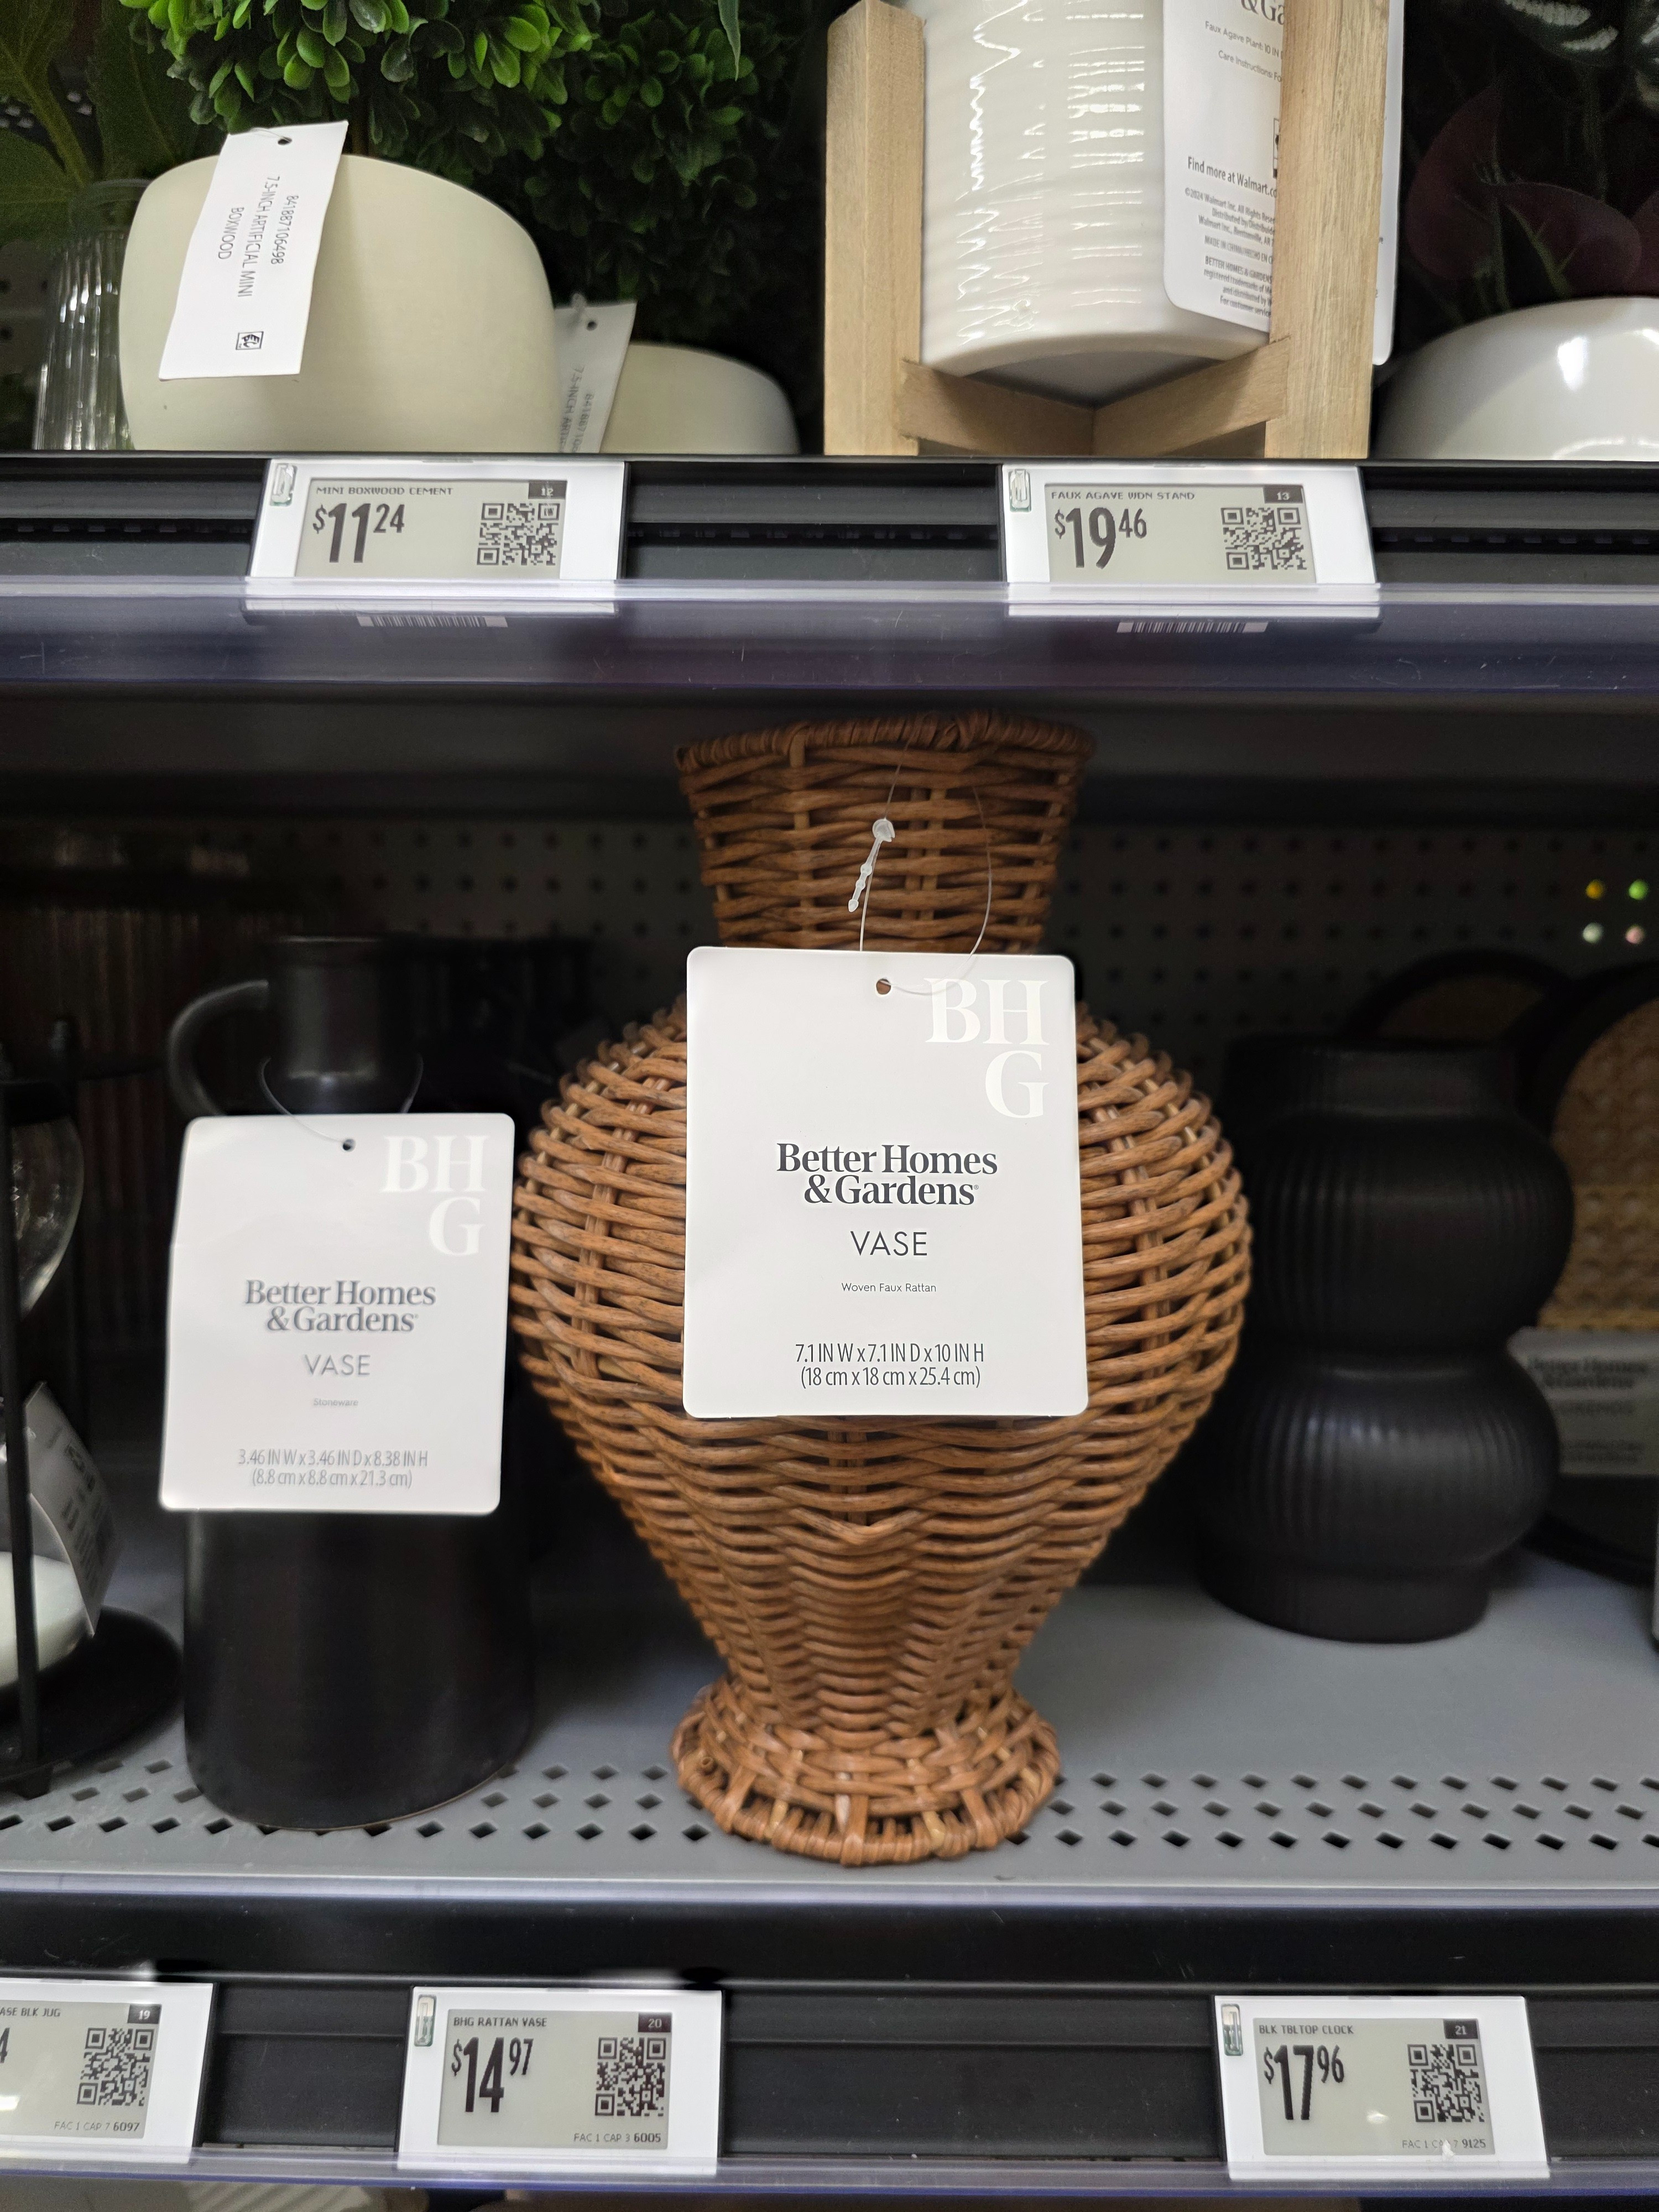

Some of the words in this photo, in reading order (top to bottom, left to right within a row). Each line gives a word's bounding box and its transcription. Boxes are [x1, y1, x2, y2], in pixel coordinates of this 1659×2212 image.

[1205, 20, 1221, 34] Faux
[1223, 28, 1244, 43] Agave
[1265, 44, 1271, 54] 10
[1272, 48, 1279, 58] IN
[1218, 50, 1234, 63] Care
[1188, 156, 1204, 174] Find
[1207, 165, 1226, 181] more
[1228, 172, 1235, 184] at
[1204, 193, 1227, 208] Walmart
[271, 195, 299, 264] 841887106498
[1198, 215, 1221, 230] Walmart
[218, 207, 244, 260] BOXWOOD
[242, 215, 268, 268] ARTIFICIAL
[1204, 235, 1220, 248] MADE
[1220, 240, 1226, 249] IN
[1205, 255, 1225, 269] BETTER
[1225, 262, 1244, 275] HOMES
[238, 270, 256, 297] MINI
[409, 487, 454, 495] CEMENT
[1086, 492, 1123, 500] AGAVE
[1157, 492, 1195, 500] STAND
[776, 1142, 877, 1172] Better
[881, 1144, 998, 1175] Homes
[850, 1230, 927, 1256] VASE
[245, 1279, 332, 1305] Better
[335, 1280, 437, 1306] Homes
[841, 1282, 876, 1292] Woven
[879, 1283, 902, 1292] Faux
[905, 1283, 937, 1292] Rattan
[796, 1344, 813, 1362] 7.1
[818, 1343, 833, 1362] IN
[837, 1343, 854, 1362] W
[857, 1348, 865, 1362] x
[868, 1344, 886, 1362] 7.1
[891, 1343, 906, 1362] IN
[910, 1343, 921, 1362] D
[924, 1348, 932, 1362] x
[935, 1344, 951, 1362] 10
[954, 1343, 969, 1362] IN
[974, 1343, 984, 1362] H
[304, 1354, 371, 1376] VASE
[801, 1366, 822, 1389] (18
[825, 1370, 847, 1385] cm
[851, 1371, 860, 1385] x
[863, 1367, 879, 1385] 18
[883, 1370, 905, 1385] cm
[908, 1371, 917, 1385] x
[920, 1366, 950, 1385] 25.4
[953, 1365, 980, 1389] cm)
[314, 1398, 359, 1407] Stoneware
[238, 1448, 265, 1465] 3.46
[268, 1449, 280, 1465] IN
[284, 1449, 298, 1465] W
[299, 1453, 306, 1465] x
[308, 1449, 335, 1465] 3.46
[338, 1449, 351, 1466] IN
[353, 1450, 363, 1466] D
[364, 1454, 371, 1466] x
[374, 1451, 400, 1466] 8.38
[404, 1451, 416, 1467] IN
[419, 1451, 429, 1467] H
[253, 1468, 275, 1486] (8.8
[278, 1472, 296, 1485] cm
[298, 1473, 306, 1485] x
[307, 1469, 327, 1485] 8.8
[330, 1473, 348, 1485] cm
[351, 1473, 358, 1485] x
[360, 1470, 387, 1486] 21.3
[389, 1469, 413, 1489] cm)
[21, 2007, 39, 2016] BLK
[42, 2008, 61, 2017] JUG
[138, 2010, 150, 2020] 19
[453, 2017, 474, 2026] BHG
[478, 2017, 519, 2027] RATTAN
[522, 2017, 547, 2027] VASE
[648, 2018, 662, 2028] 20
[1259, 2025, 1277, 2034] BLK
[1281, 2025, 1318, 2034] TBLTOP
[1322, 2025, 1354, 2034] CLOCK
[1455, 2025, 1467, 2035] 21
[54, 2121, 72, 2130] FAC
[84, 2122, 102, 2131] CAP
[113, 2122, 140, 2131] 6097
[573, 2133, 593, 2142] FAC
[596, 2133, 600, 2142] 1
[603, 2133, 622, 2142] CAP
[625, 2133, 630, 2142] 3
[634, 2133, 661, 2142] 6005
[1402, 2140, 1421, 2148] FAC
[1462, 2138, 1486, 2148] 9125
